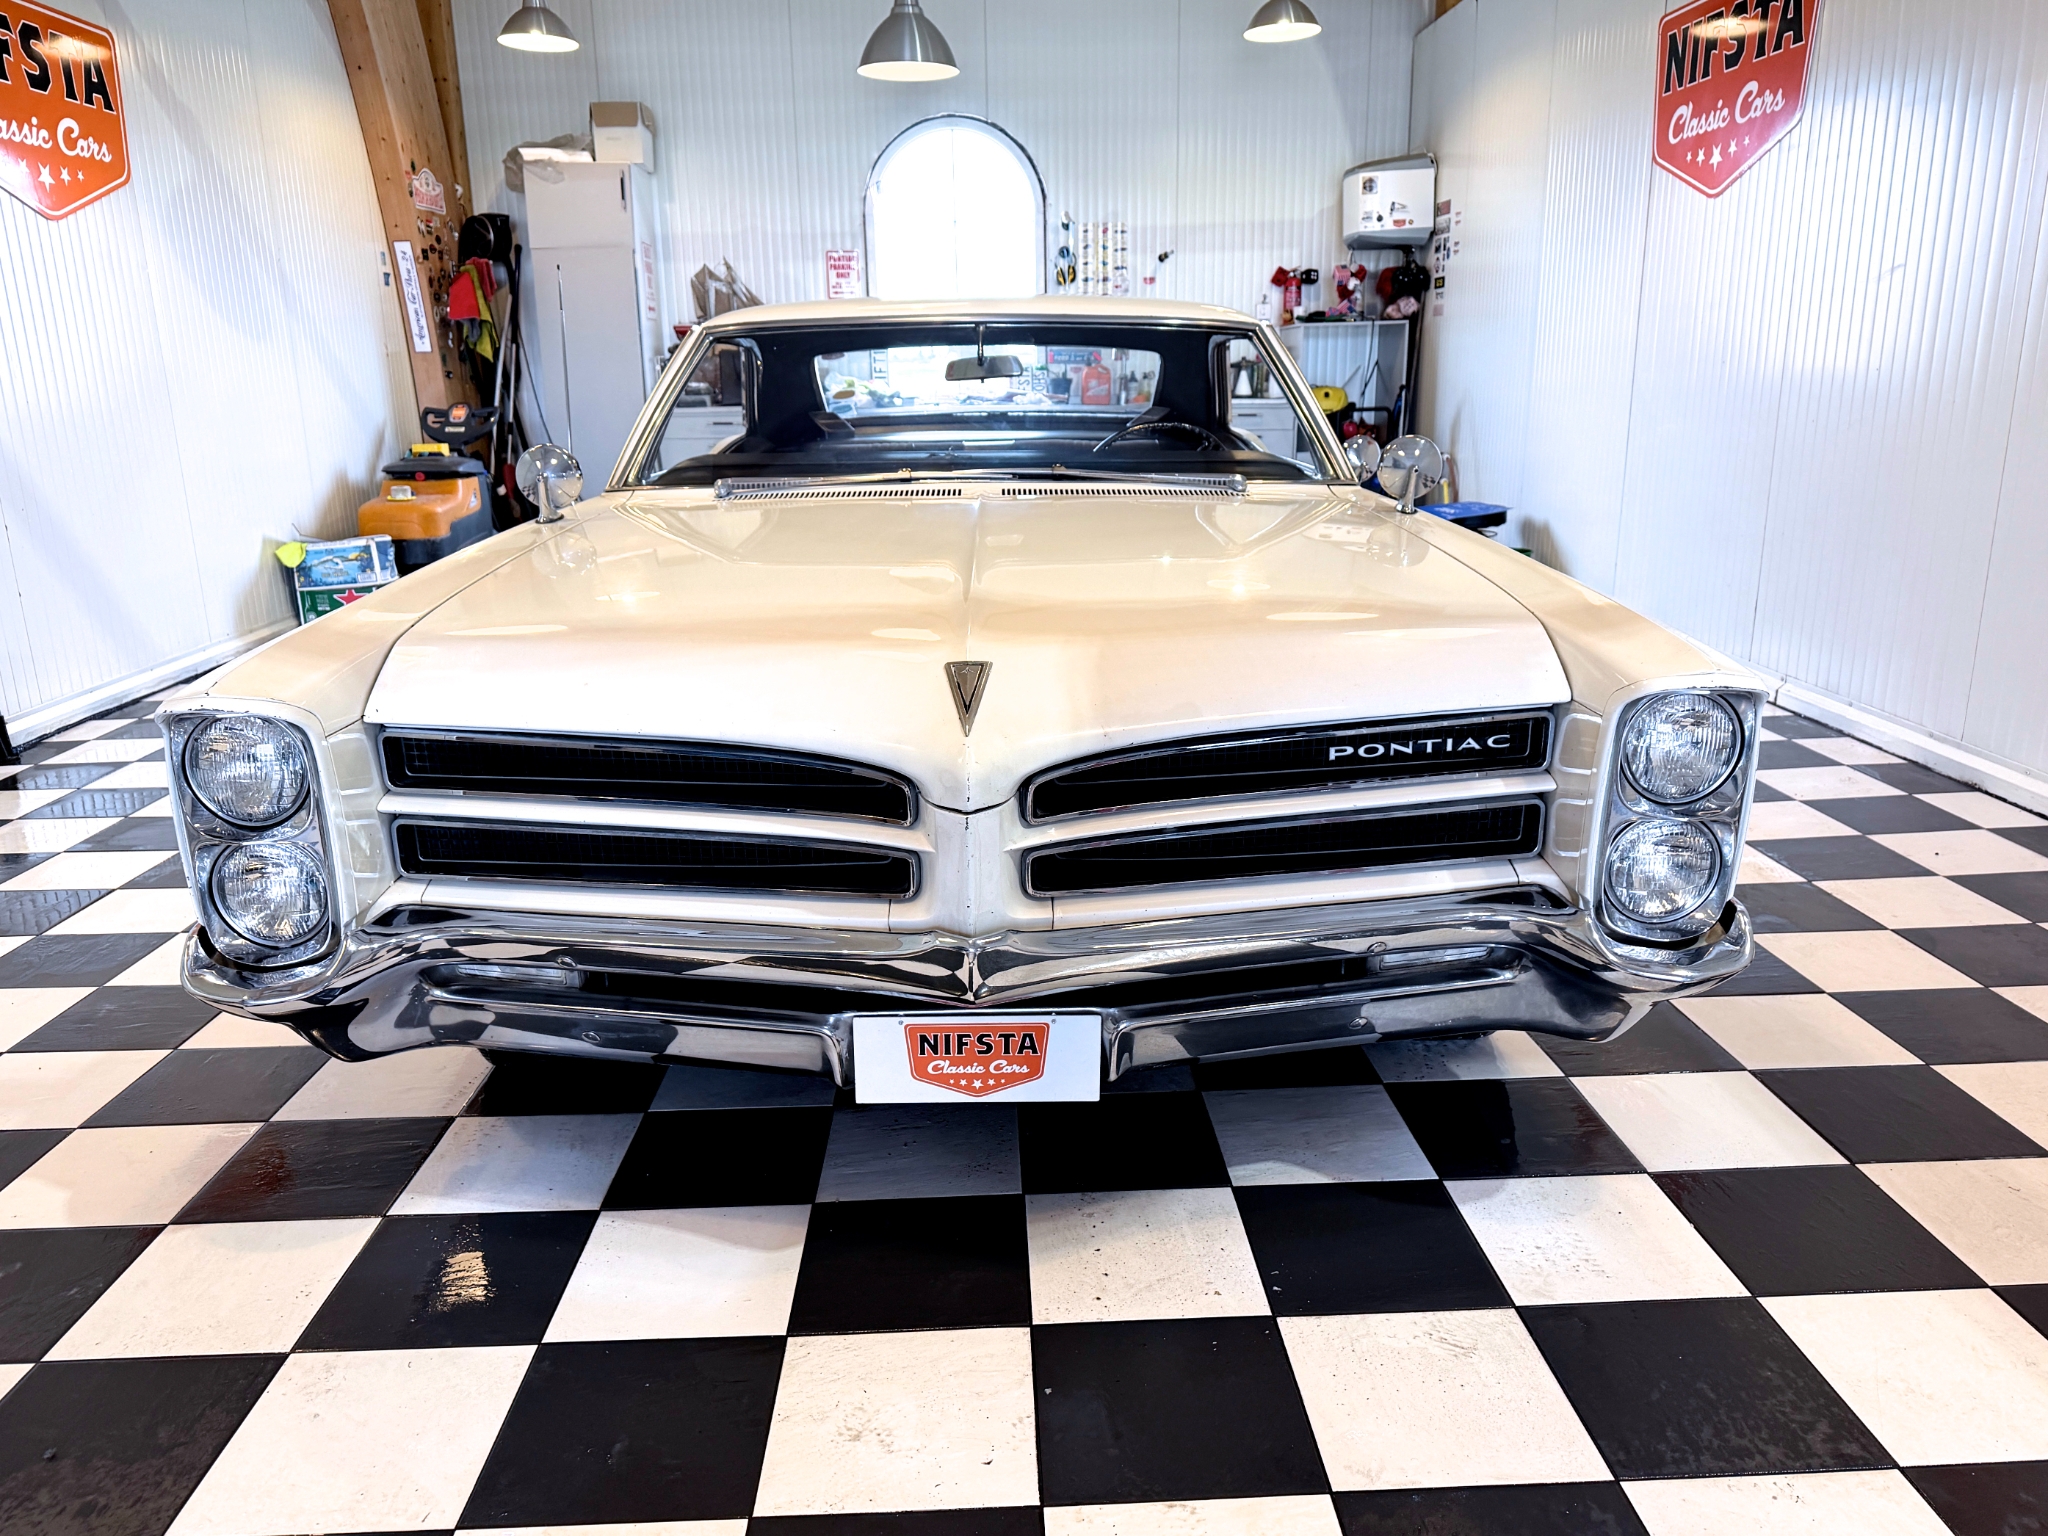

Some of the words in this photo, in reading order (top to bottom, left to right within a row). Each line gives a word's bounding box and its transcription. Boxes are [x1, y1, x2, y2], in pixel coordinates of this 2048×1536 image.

[0, 12, 117, 114] FSTA
[1663, 0, 1806, 97] NIFSTA
[1668, 98, 1730, 145] Classic
[1735, 81, 1785, 124] Cars
[0, 116, 52, 149] assic
[57, 118, 112, 162] Cars
[1329, 734, 1511, 761] PONTIAC
[917, 1032, 1041, 1057] NIFSTA
[926, 1060, 986, 1075] Classic
[989, 1059, 1030, 1075] Cars
